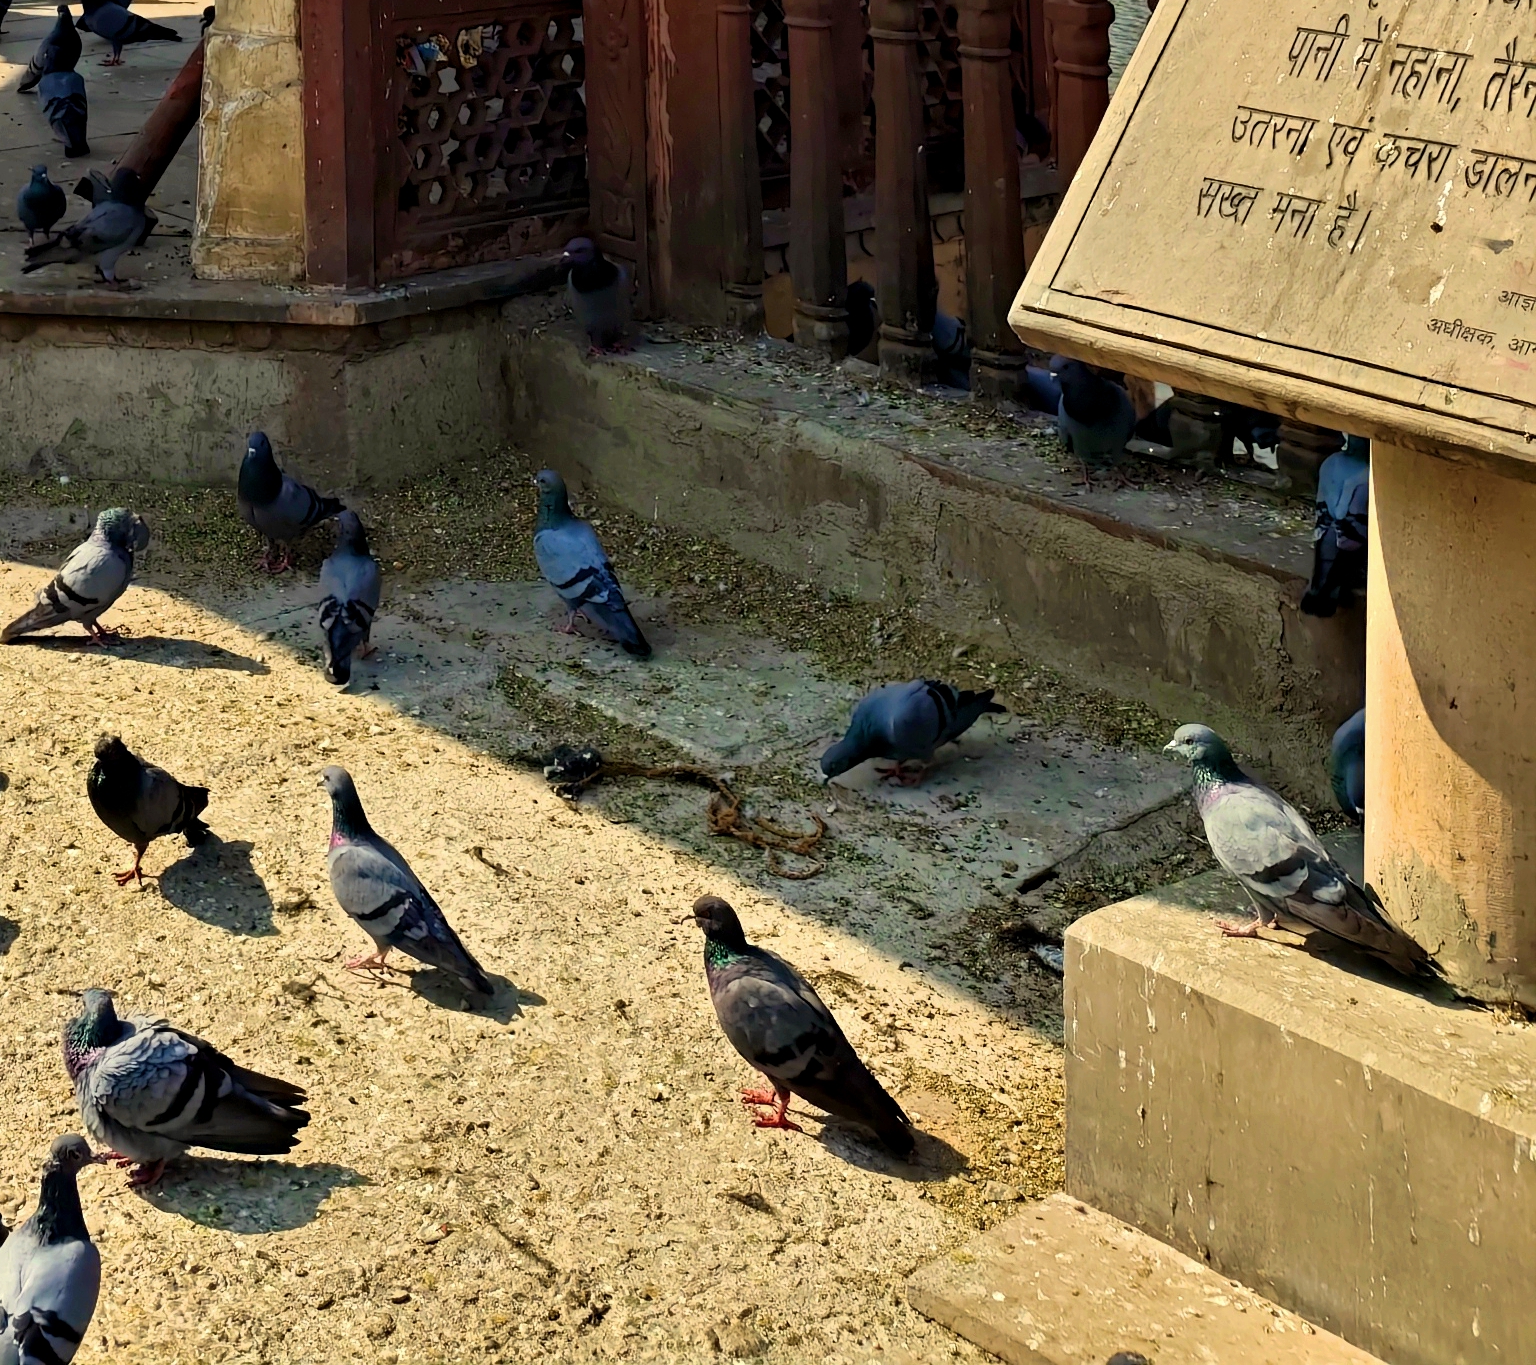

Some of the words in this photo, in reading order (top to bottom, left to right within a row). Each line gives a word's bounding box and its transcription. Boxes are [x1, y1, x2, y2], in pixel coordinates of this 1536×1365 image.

[1288, 13, 1351, 82] पानी
[1353, 16, 1389, 90] में
[1389, 44, 1474, 113] नहाना,
[1232, 105, 1320, 156] उतरना
[1326, 116, 1375, 169] एवं
[1375, 133, 1460, 183] कचरा
[1197, 177, 1264, 226] सख्त
[1272, 192, 1326, 239] मना
